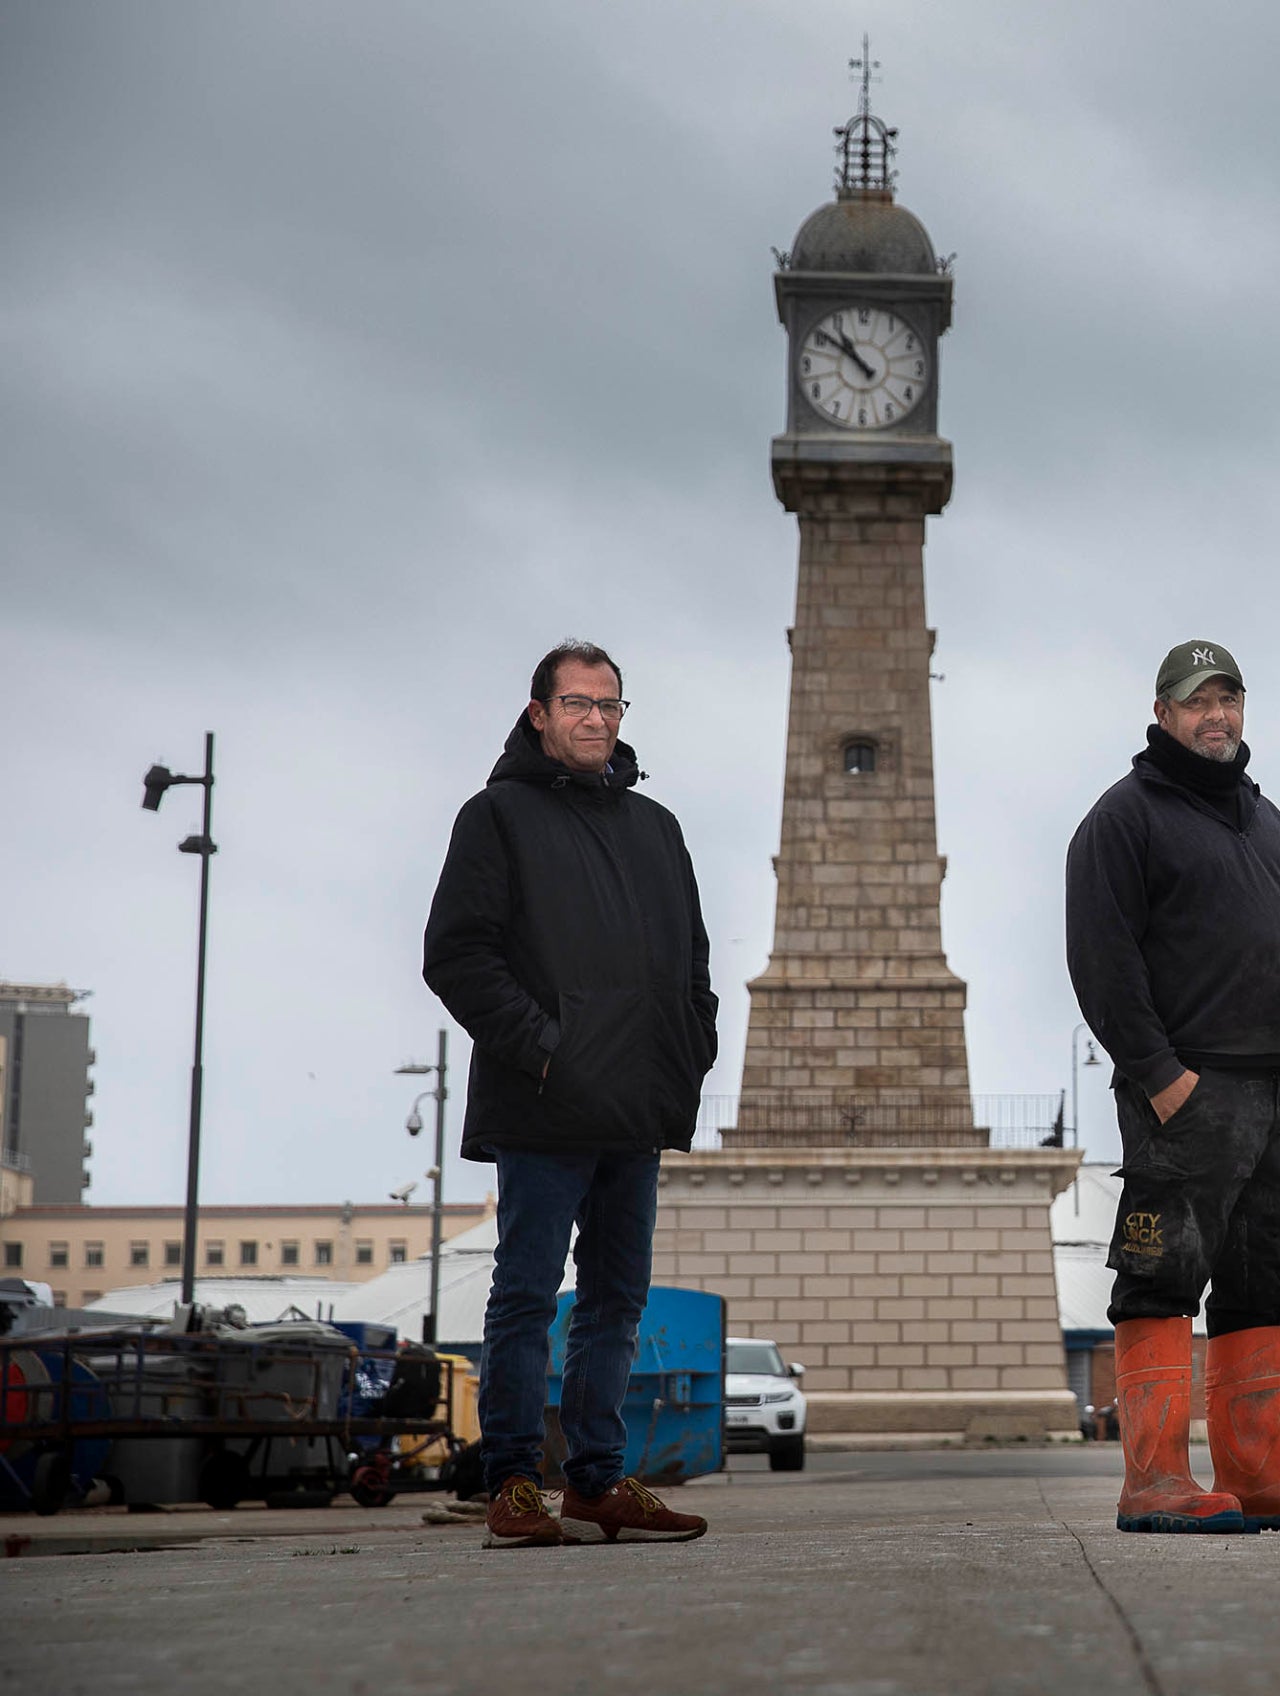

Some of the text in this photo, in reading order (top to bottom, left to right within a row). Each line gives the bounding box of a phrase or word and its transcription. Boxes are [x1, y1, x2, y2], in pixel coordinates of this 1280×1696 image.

[905, 333, 914, 351] 2
[802, 356, 811, 373] 9
[915, 360, 924, 377] 3
[812, 382, 820, 399] 8
[833, 400, 841, 417] 7
[858, 408, 867, 426] 6
[885, 403, 894, 420] 5
[1192, 648, 1216, 666] NY
